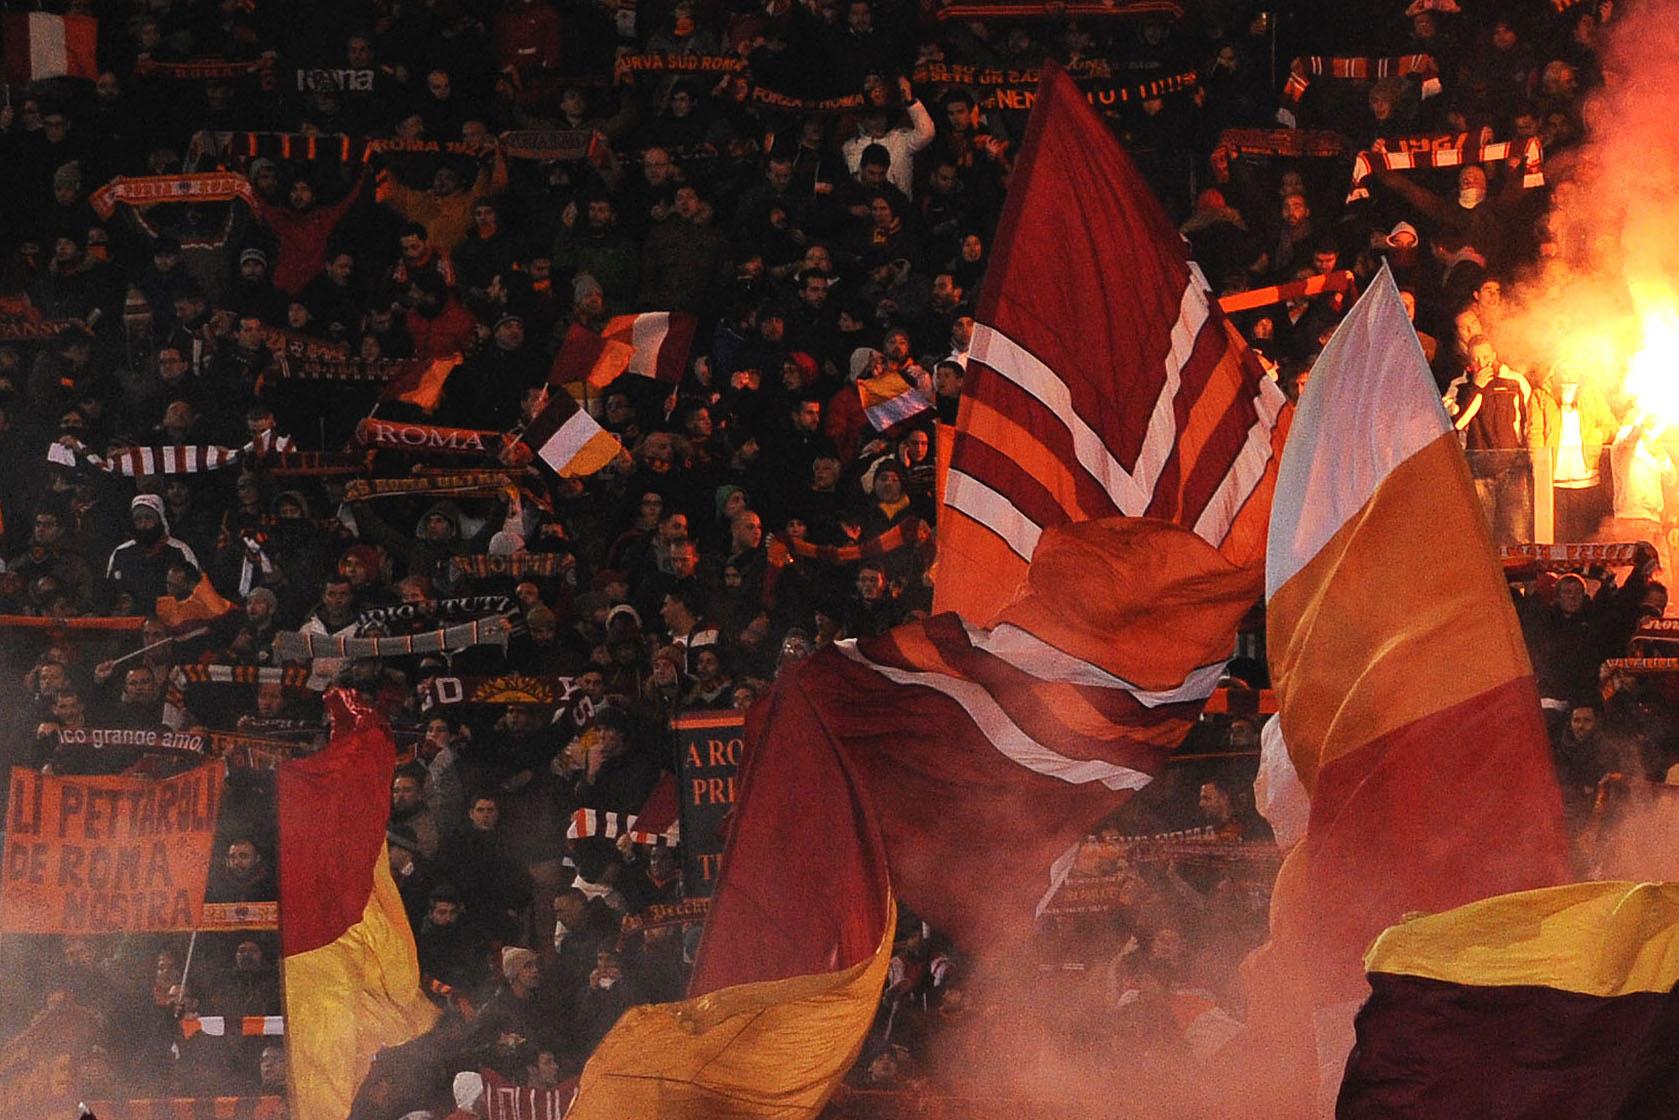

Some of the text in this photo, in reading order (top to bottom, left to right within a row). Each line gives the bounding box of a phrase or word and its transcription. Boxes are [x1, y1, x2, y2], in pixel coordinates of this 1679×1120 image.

[375, 424, 487, 451] ROMA
[91, 728, 158, 750] grande
[57, 841, 174, 890] ROMA
